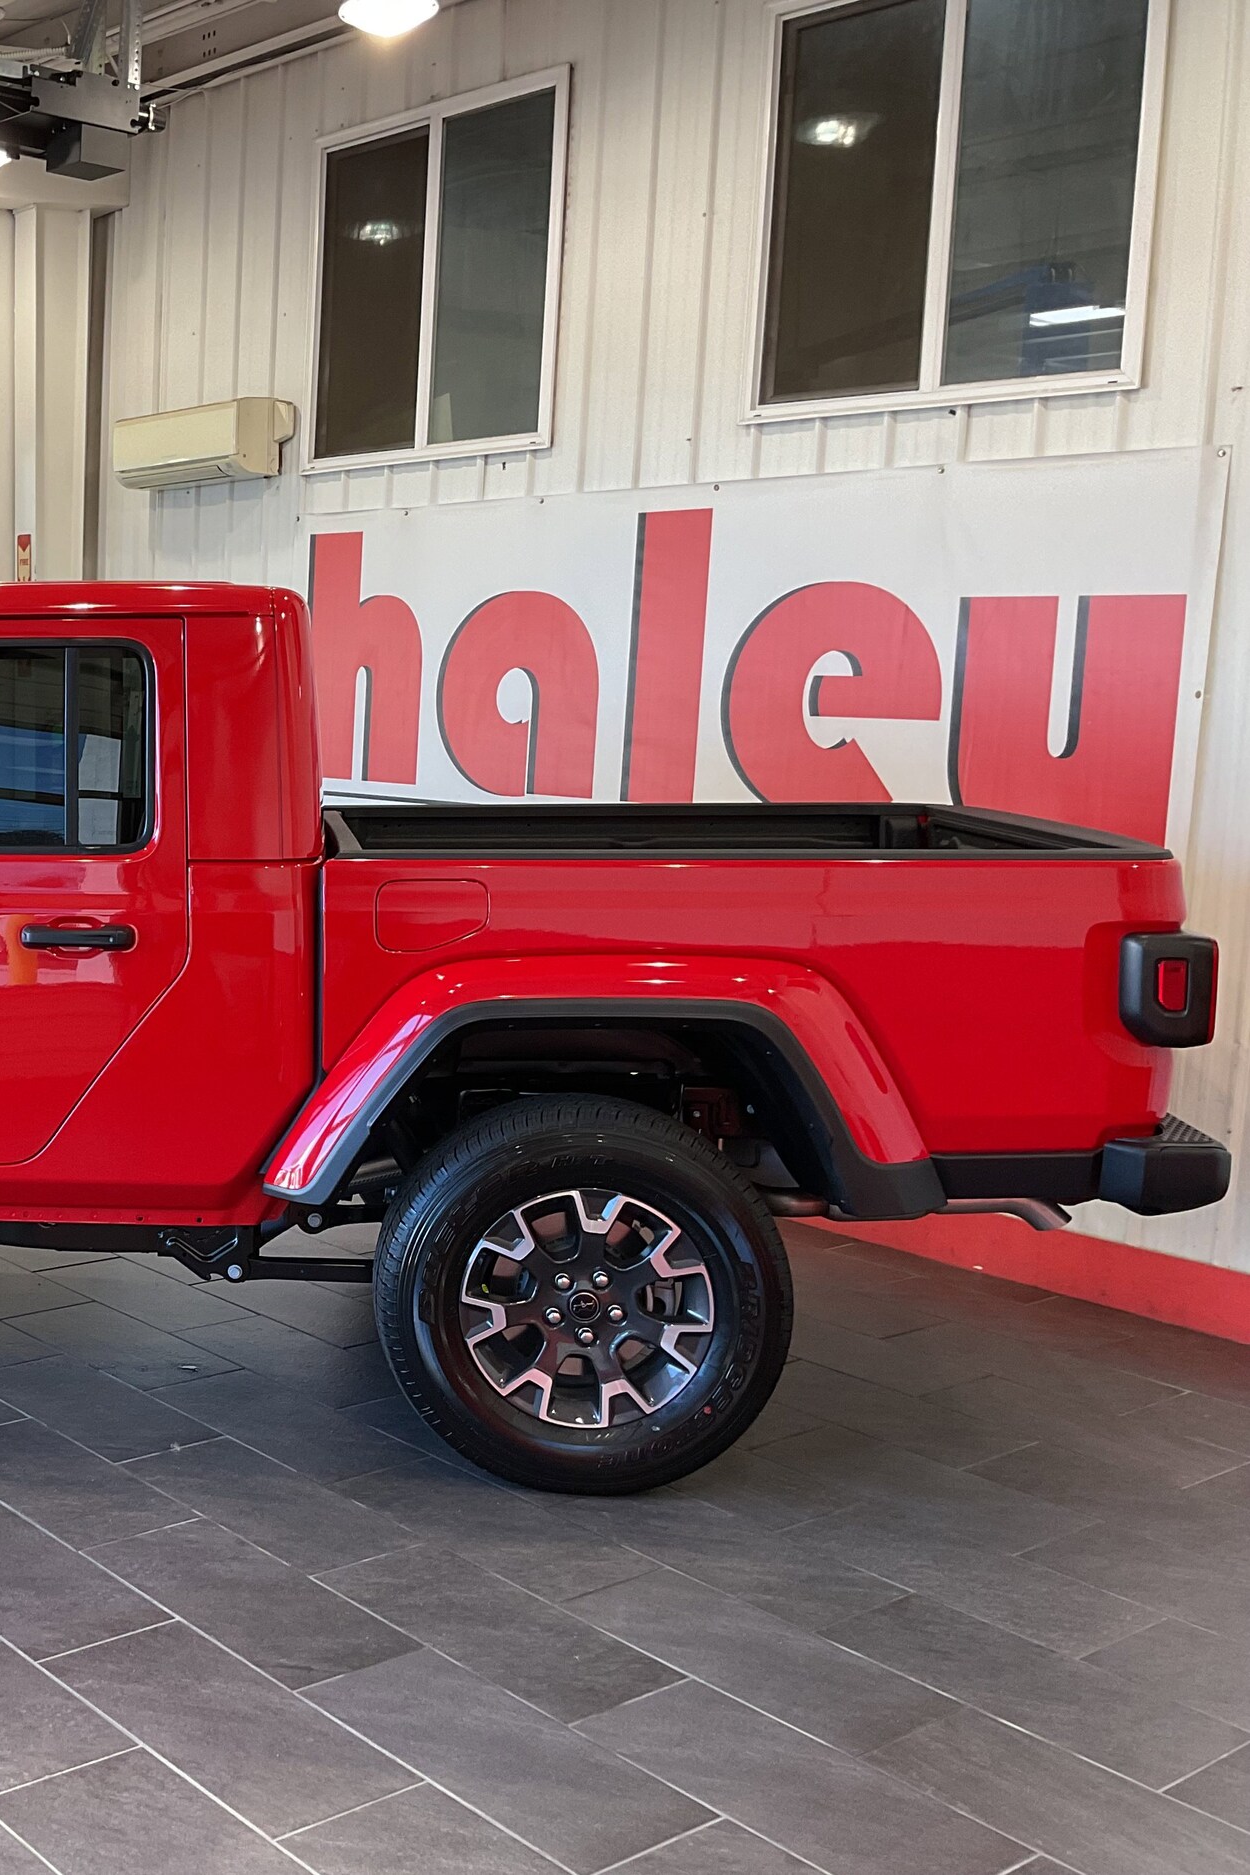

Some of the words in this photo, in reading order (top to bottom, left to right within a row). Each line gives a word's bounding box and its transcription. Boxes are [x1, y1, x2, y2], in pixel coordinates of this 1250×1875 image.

[307, 509, 1188, 850] haley
[418, 1159, 540, 1330] DUELER
[598, 1262, 759, 1469] BRIDGESTONE
